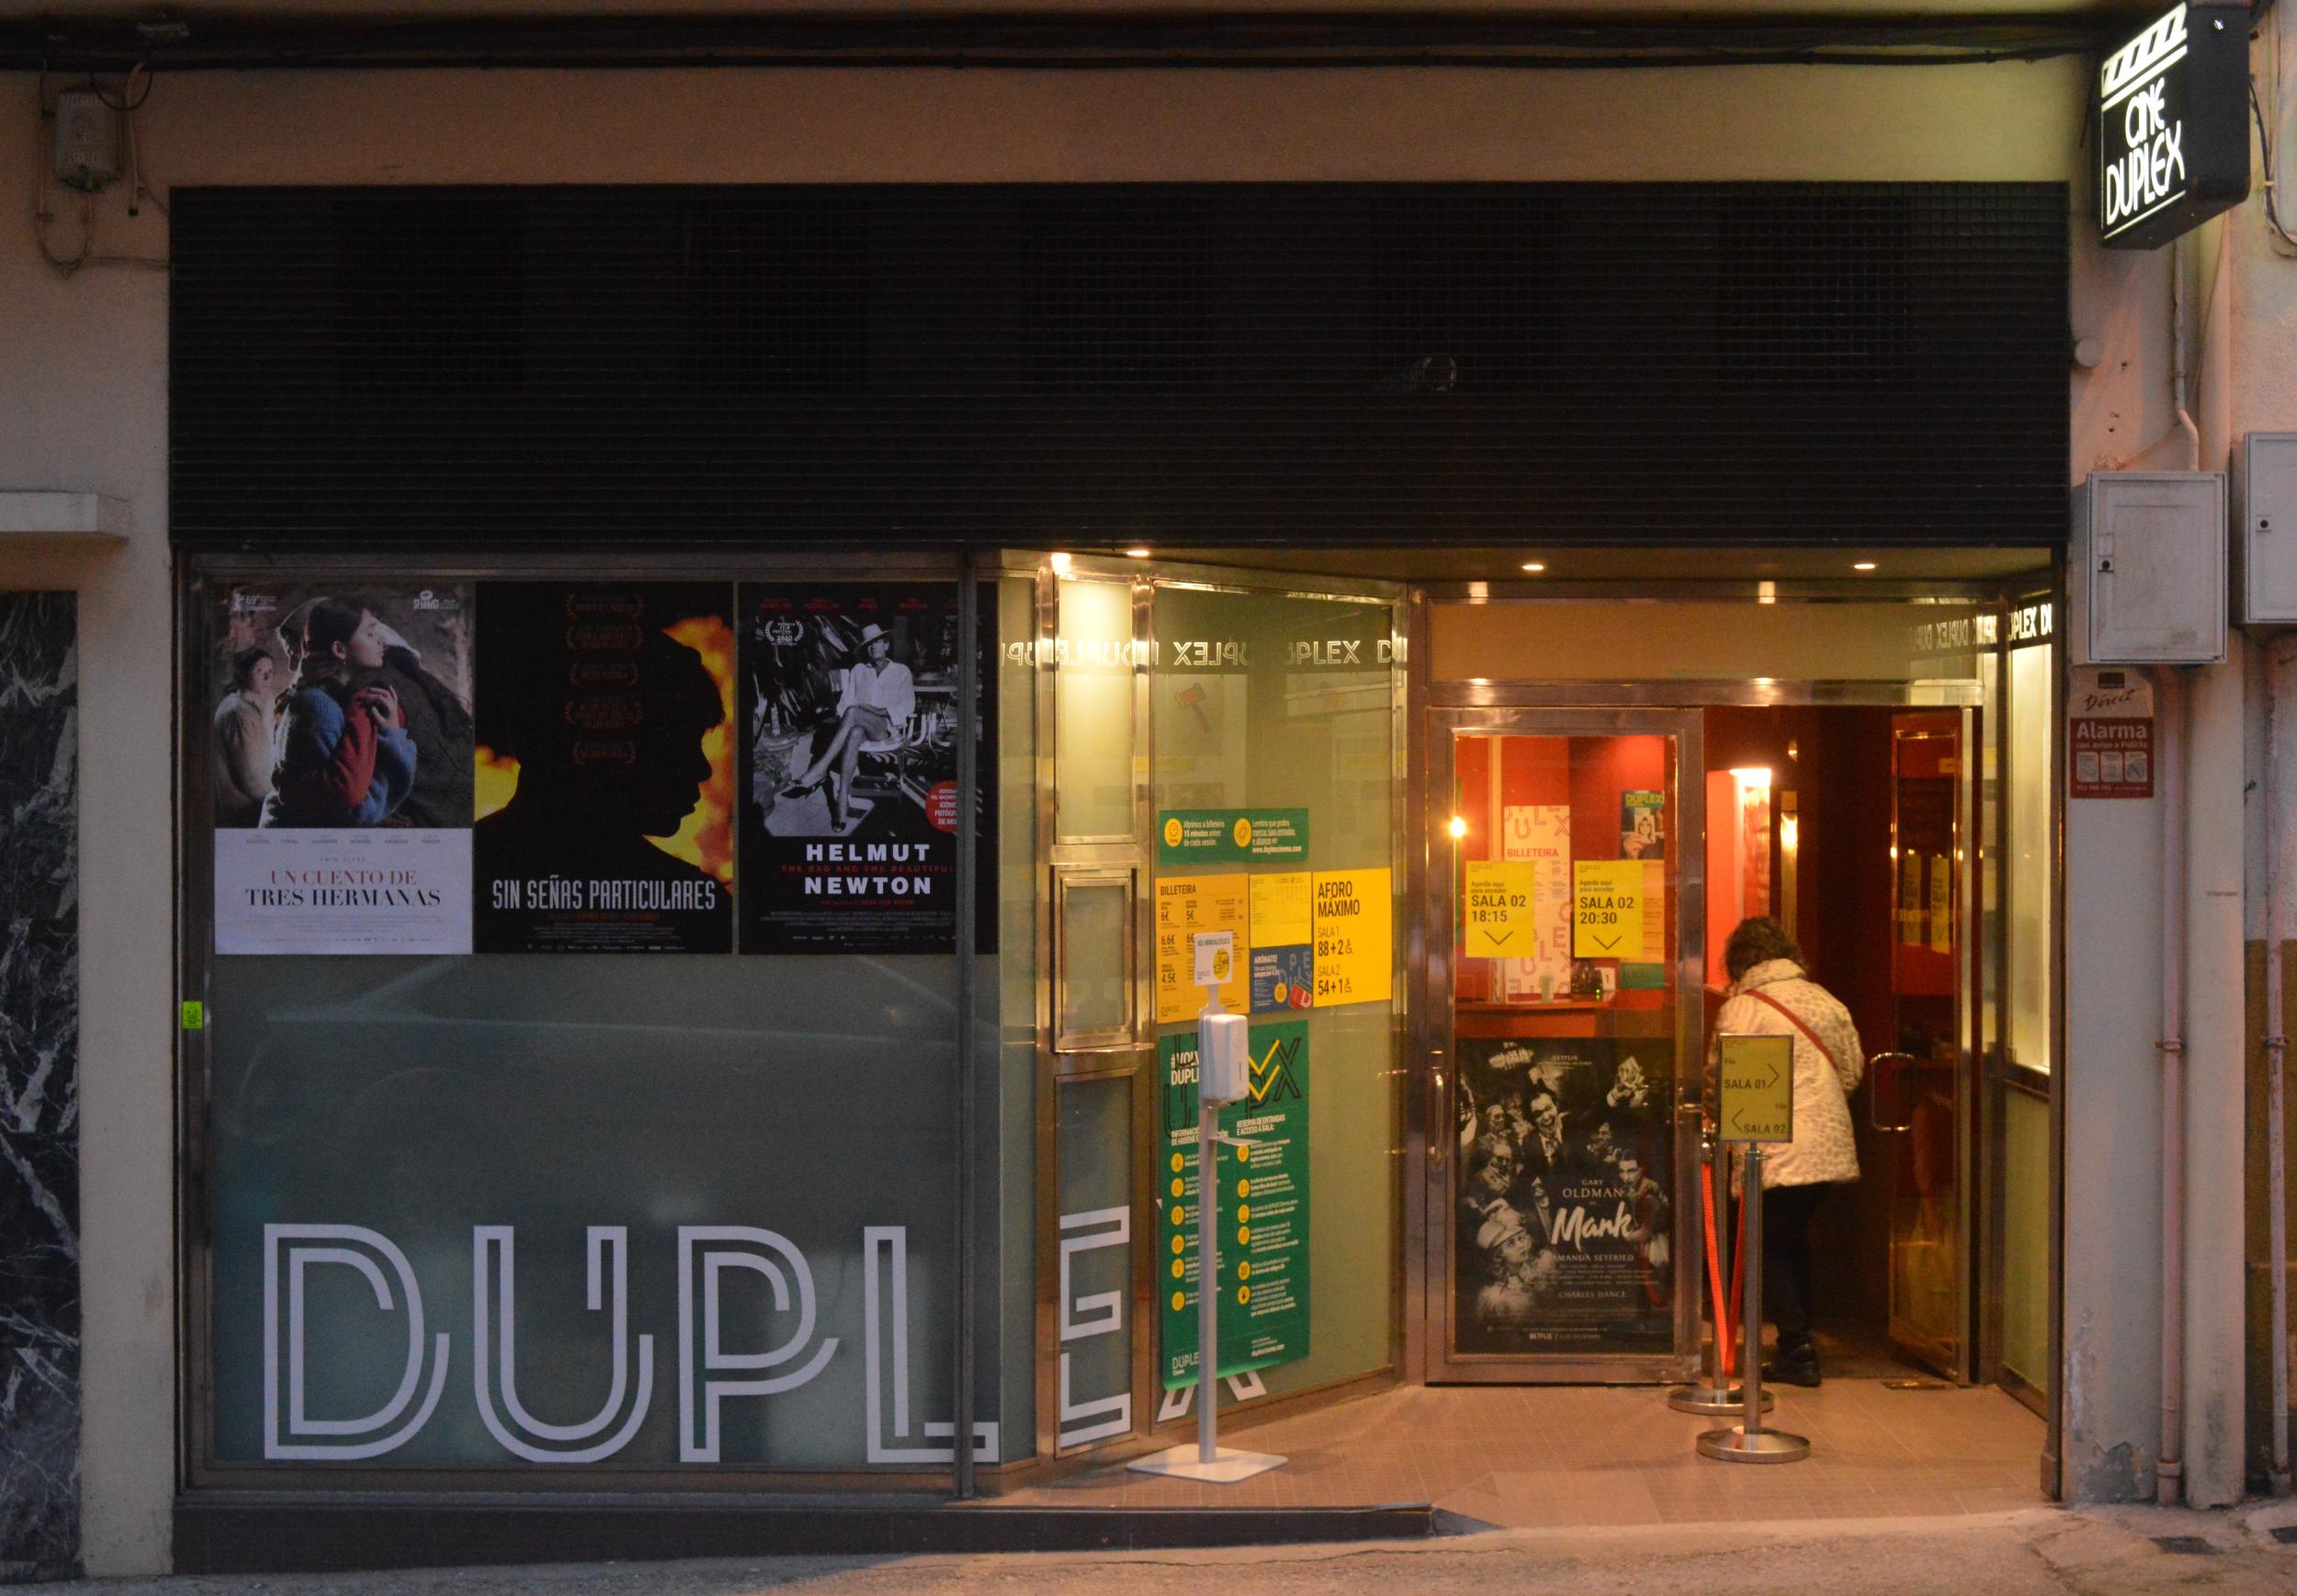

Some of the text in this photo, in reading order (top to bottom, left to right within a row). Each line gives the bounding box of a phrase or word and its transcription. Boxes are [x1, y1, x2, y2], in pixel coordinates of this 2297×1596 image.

[2125, 77, 2165, 148] CINE
[2106, 119, 2185, 225] DUPLEX
[2076, 721, 2147, 739] Alarma
[806, 843, 930, 862] HELMUT
[1508, 848, 1559, 857] BILLETEIRA
[270, 870, 417, 885] UN CUENTO DE
[492, 874, 716, 910] SIN SEÑAS PARTICULARES
[805, 877, 931, 895] NEWTON
[1160, 884, 1197, 896] BILLETEIRA
[1318, 880, 1352, 899] AFORO
[245, 889, 441, 906] TRES HERMANAS
[1471, 895, 1527, 907] SALA 02
[1579, 896, 1635, 909] SALA 02
[1318, 897, 1360, 918] MÁXIMO
[1472, 911, 1508, 923] 18:15
[1579, 911, 1617, 924] 20:30
[1318, 927, 1336, 937] SALA
[1318, 940, 1330, 956] 88
[1338, 939, 1344, 956] 2
[1318, 965, 1335, 977] SALA
[1318, 979, 1330, 995] 54
[1171, 1068, 1198, 1086] DUPL
[1725, 1079, 1766, 1089] SALA 01
[1744, 1124, 1786, 1134] SALA 02
[1562, 1187, 1624, 1198] OLDMAN
[1551, 1200, 1632, 1251] Mank
[1594, 1253, 1634, 1262] SEYFRIED
[1172, 1353, 1199, 1370] DUPLE
